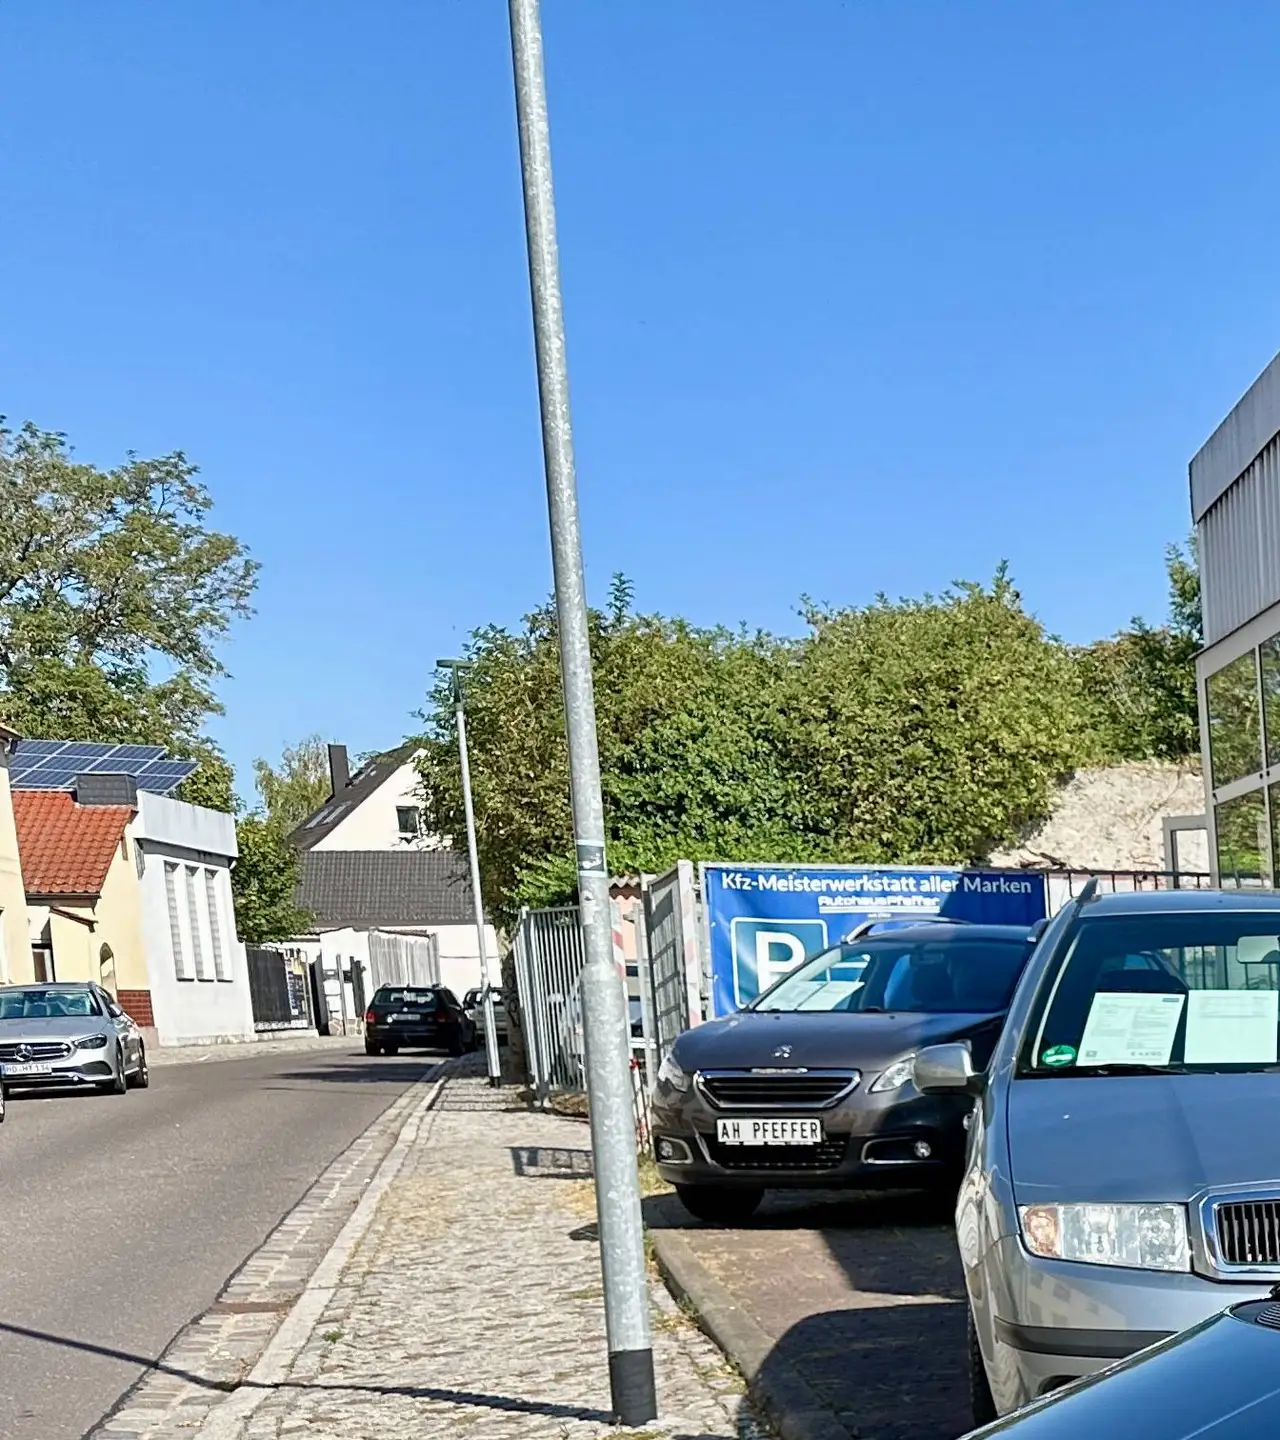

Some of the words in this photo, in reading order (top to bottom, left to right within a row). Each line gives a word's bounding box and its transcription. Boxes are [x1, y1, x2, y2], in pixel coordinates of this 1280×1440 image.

[721, 871, 917, 893] Kfz-Meisterwerkstatt
[919, 875, 959, 893] aller
[963, 876, 1032, 894] Marken
[755, 930, 806, 994] P
[721, 1122, 740, 1139] AH
[752, 1121, 818, 1139] PFEFFER
